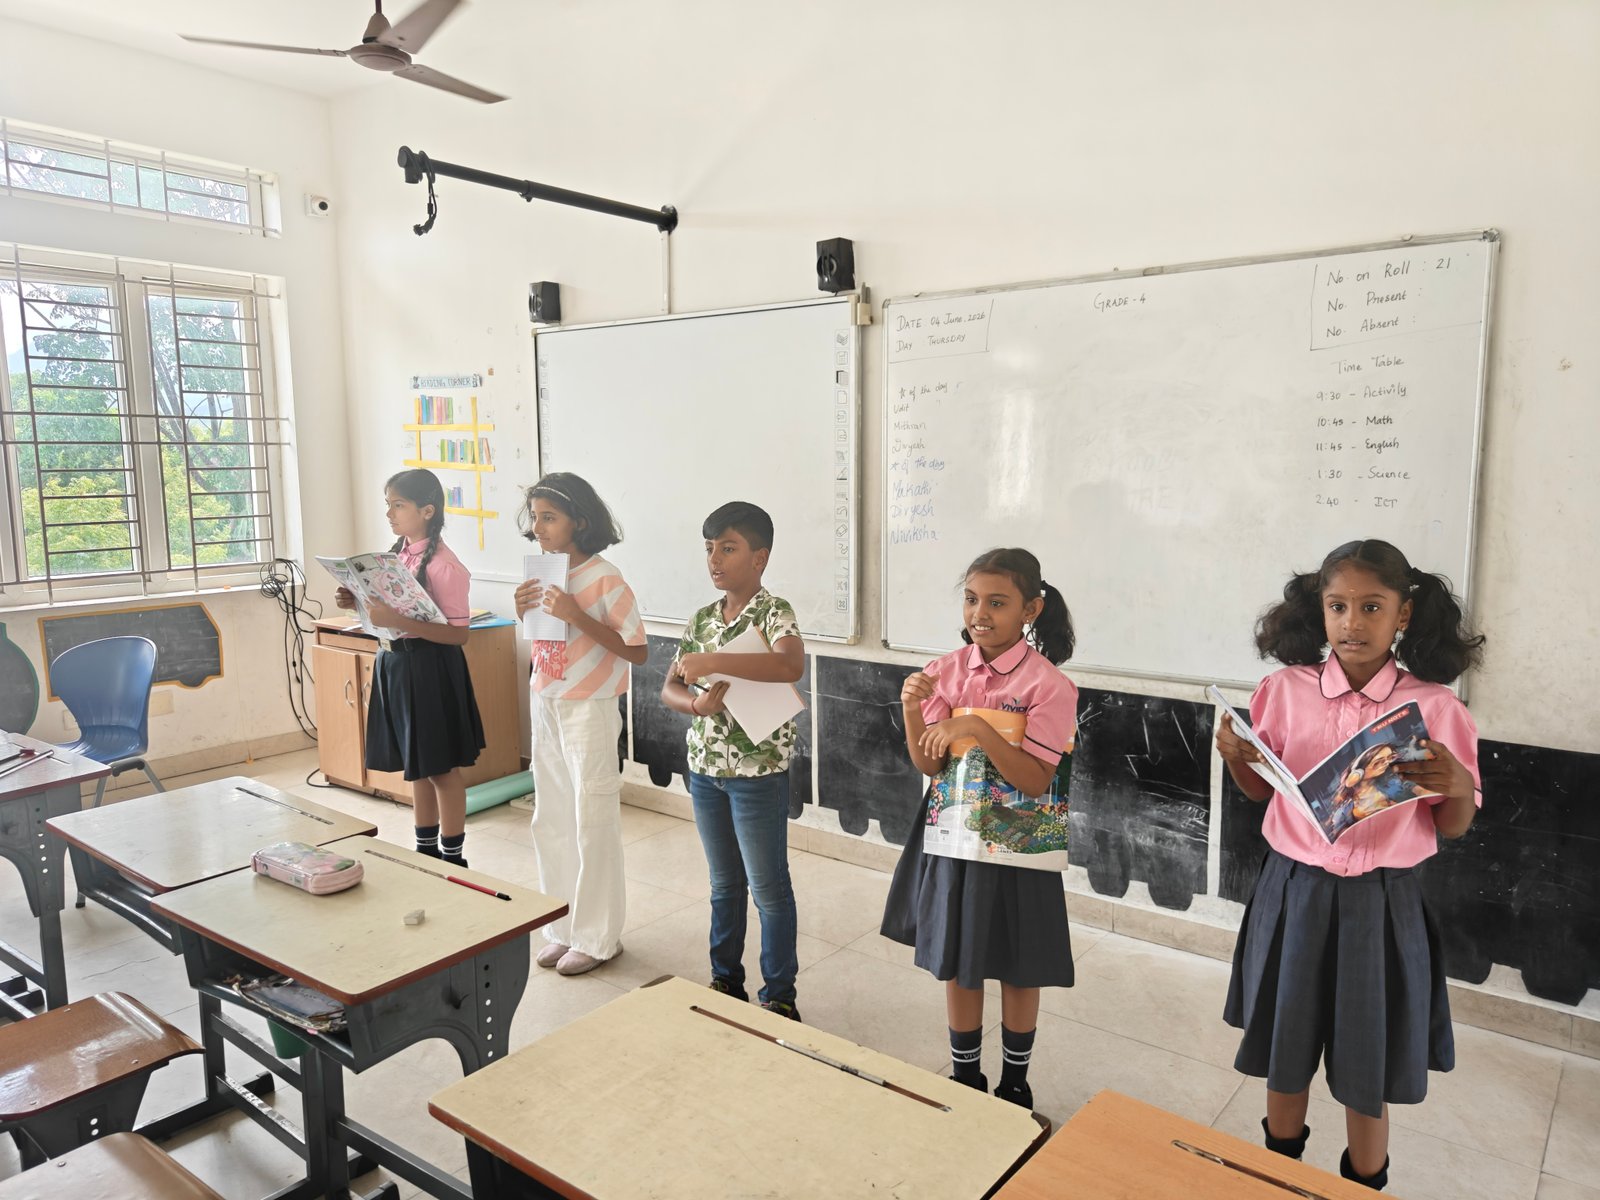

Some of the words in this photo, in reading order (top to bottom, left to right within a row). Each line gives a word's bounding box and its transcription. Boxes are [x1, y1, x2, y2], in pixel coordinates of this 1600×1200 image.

[1356, 271, 1370, 282] on
[1384, 260, 1411, 279] Roll
[1435, 257, 1451, 270] 21
[1366, 290, 1407, 306] Present
[896, 315, 922, 332] DATE
[930, 316, 940, 327] 04
[1360, 316, 1399, 332] Absent
[895, 340, 913, 353] DAY
[927, 334, 966, 346] THURSDAY
[1330, 359, 1362, 375] Time
[1371, 354, 1405, 367] Table
[447, 377, 471, 387] CORNER
[1316, 391, 1341, 402] 9:30
[1317, 415, 1344, 428] 10:45
[1365, 415, 1393, 426] Math
[1316, 442, 1343, 452] 11:45
[1365, 436, 1400, 455] English
[1317, 469, 1343, 479] 1:30
[1367, 465, 1411, 480] Science
[1374, 496, 1398, 508] ICT
